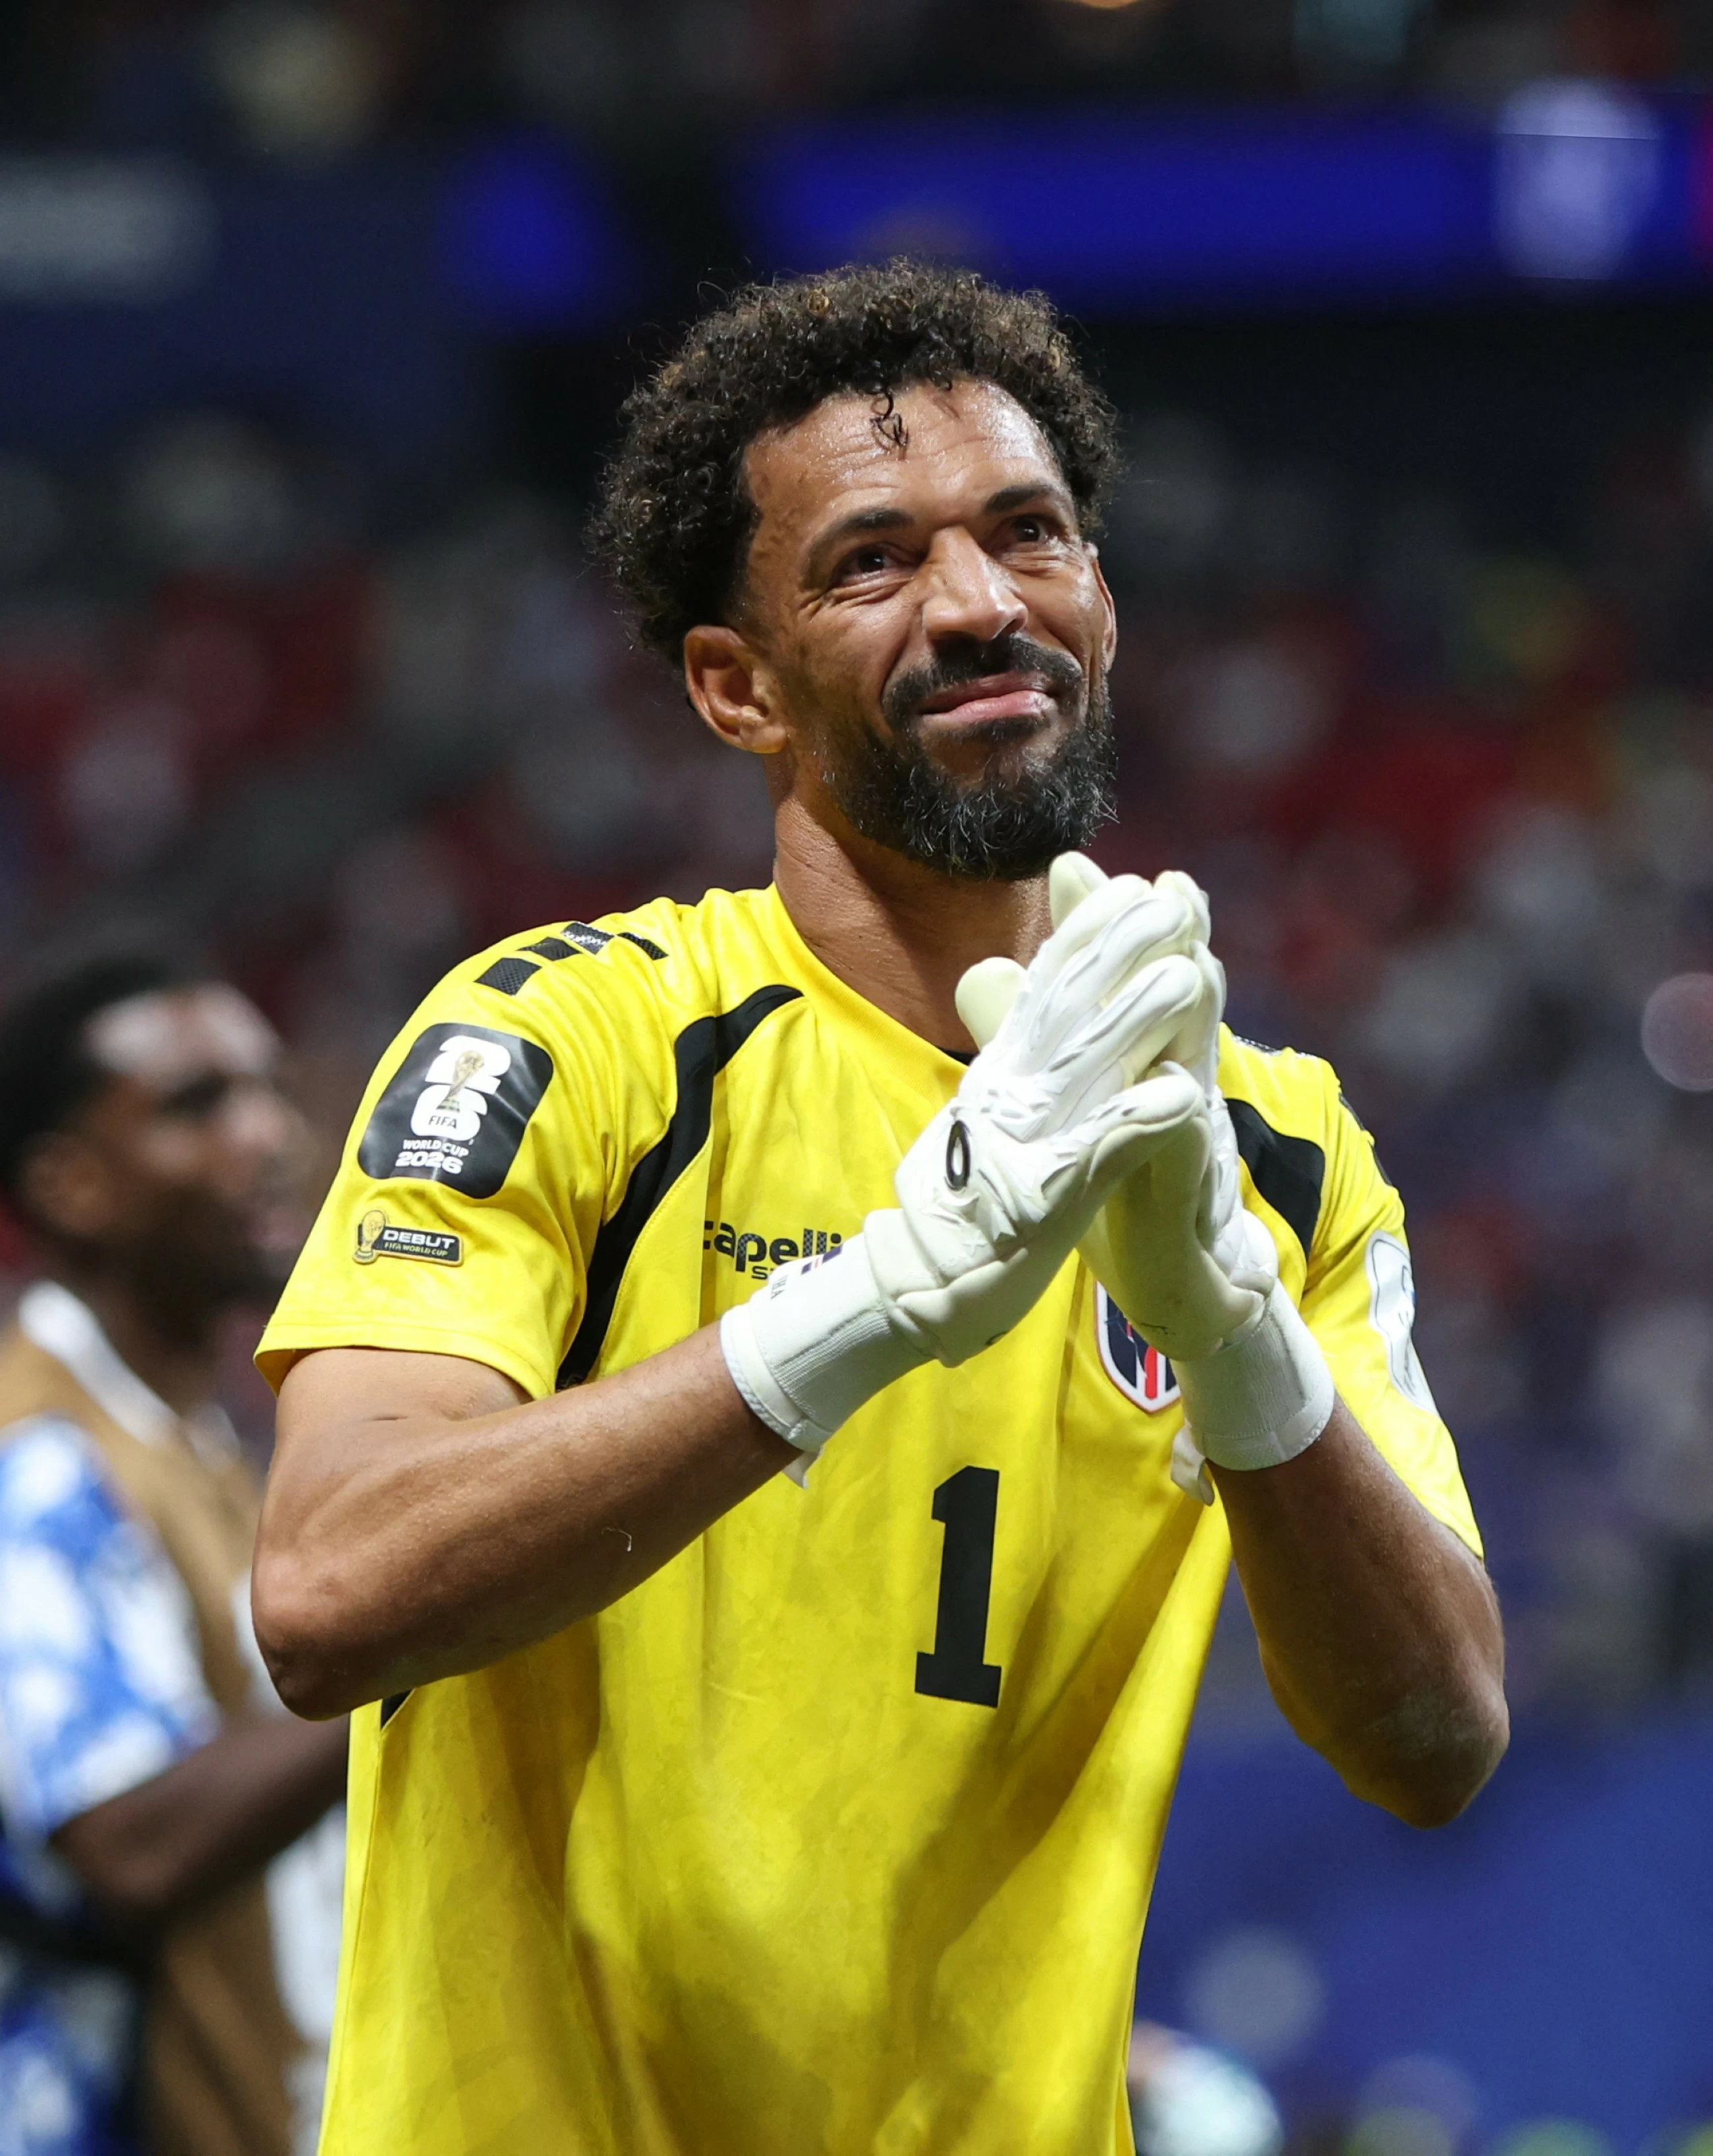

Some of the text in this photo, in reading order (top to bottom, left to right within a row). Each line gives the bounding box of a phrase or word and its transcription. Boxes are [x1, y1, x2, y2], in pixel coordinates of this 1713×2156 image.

[428, 1115, 457, 1129] FIFA
[403, 1139, 469, 1158] WORLD CUP
[395, 1150, 464, 1175] 2026
[383, 1230, 456, 1249] DEBUT
[384, 1241, 449, 1257] FIFA WORLD CUP
[703, 1220, 842, 1272] apell
[915, 1465, 1001, 1708] 1
